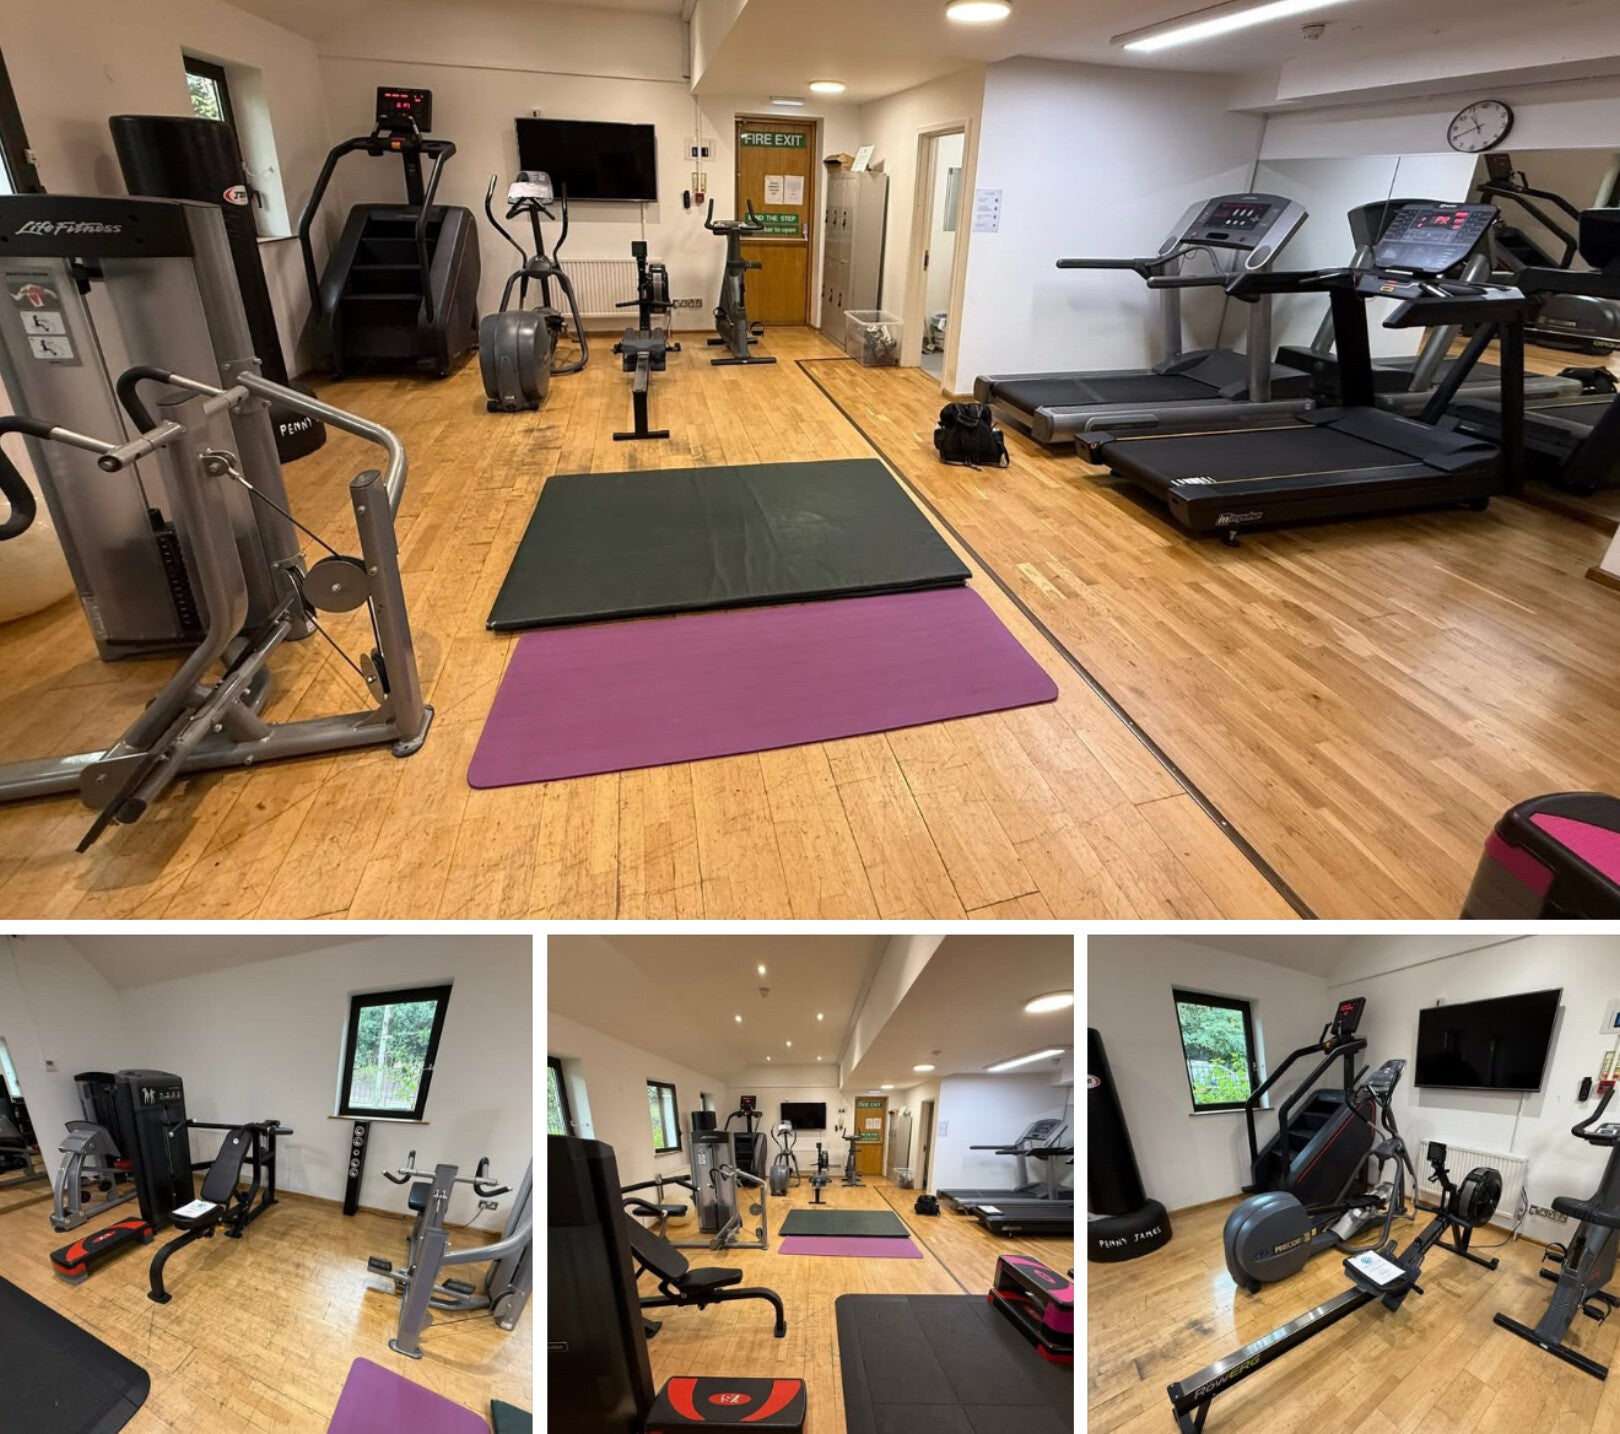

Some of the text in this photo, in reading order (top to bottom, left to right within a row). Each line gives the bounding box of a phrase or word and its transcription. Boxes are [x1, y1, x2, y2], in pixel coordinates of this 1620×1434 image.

[744, 133, 802, 146] FIRE EXIT
[15, 221, 54, 236] Life
[1098, 1226, 1162, 1249] PENNY JAMES
